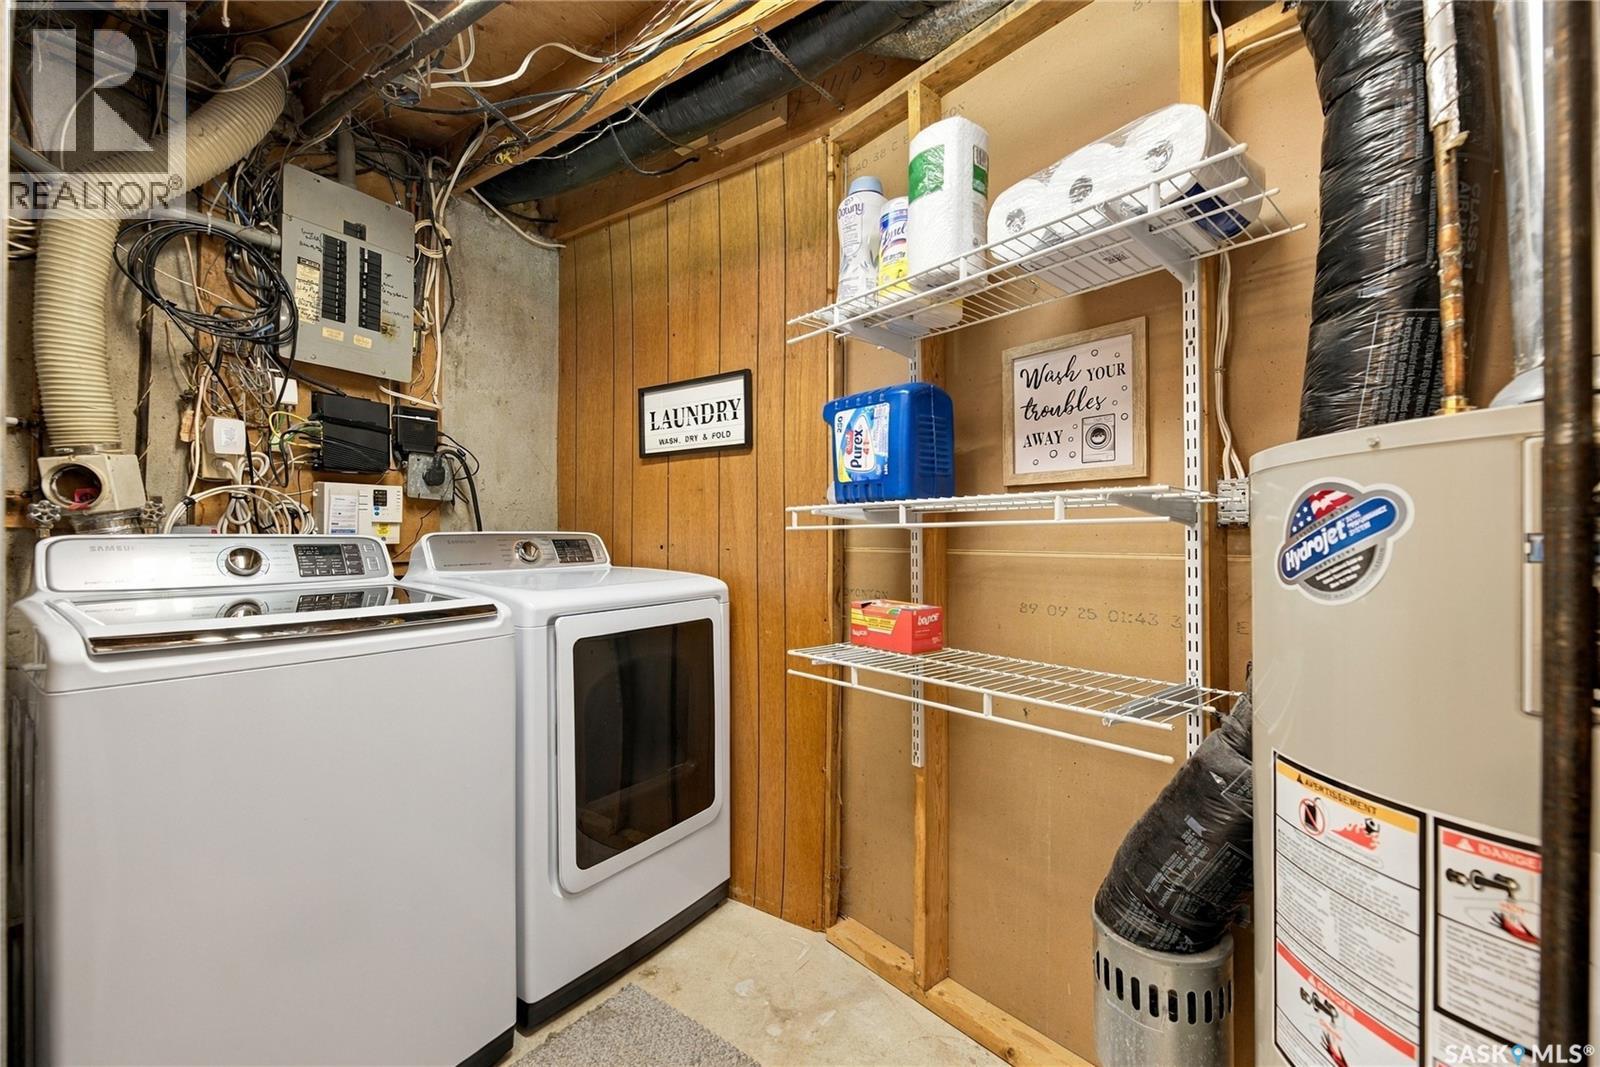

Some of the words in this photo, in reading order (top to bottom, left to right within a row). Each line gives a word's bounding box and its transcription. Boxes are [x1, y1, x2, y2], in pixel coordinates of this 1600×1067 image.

[1467, 182, 1481, 252] CLASS
[1019, 354, 1082, 390] Wash
[1086, 362, 1126, 382] YOUR
[649, 398, 741, 432] LAUNDRY
[1020, 385, 1107, 421] troubles
[684, 435, 699, 443] DRY
[702, 433, 708, 441] &
[711, 430, 731, 439] FOLD
[850, 428, 864, 469] Purex
[1023, 429, 1063, 448] AWAY
[1285, 519, 1347, 571] Hydrojet
[1019, 602, 1038, 614] 89
[1047, 604, 1067, 617] 09
[1078, 607, 1097, 620] 25
